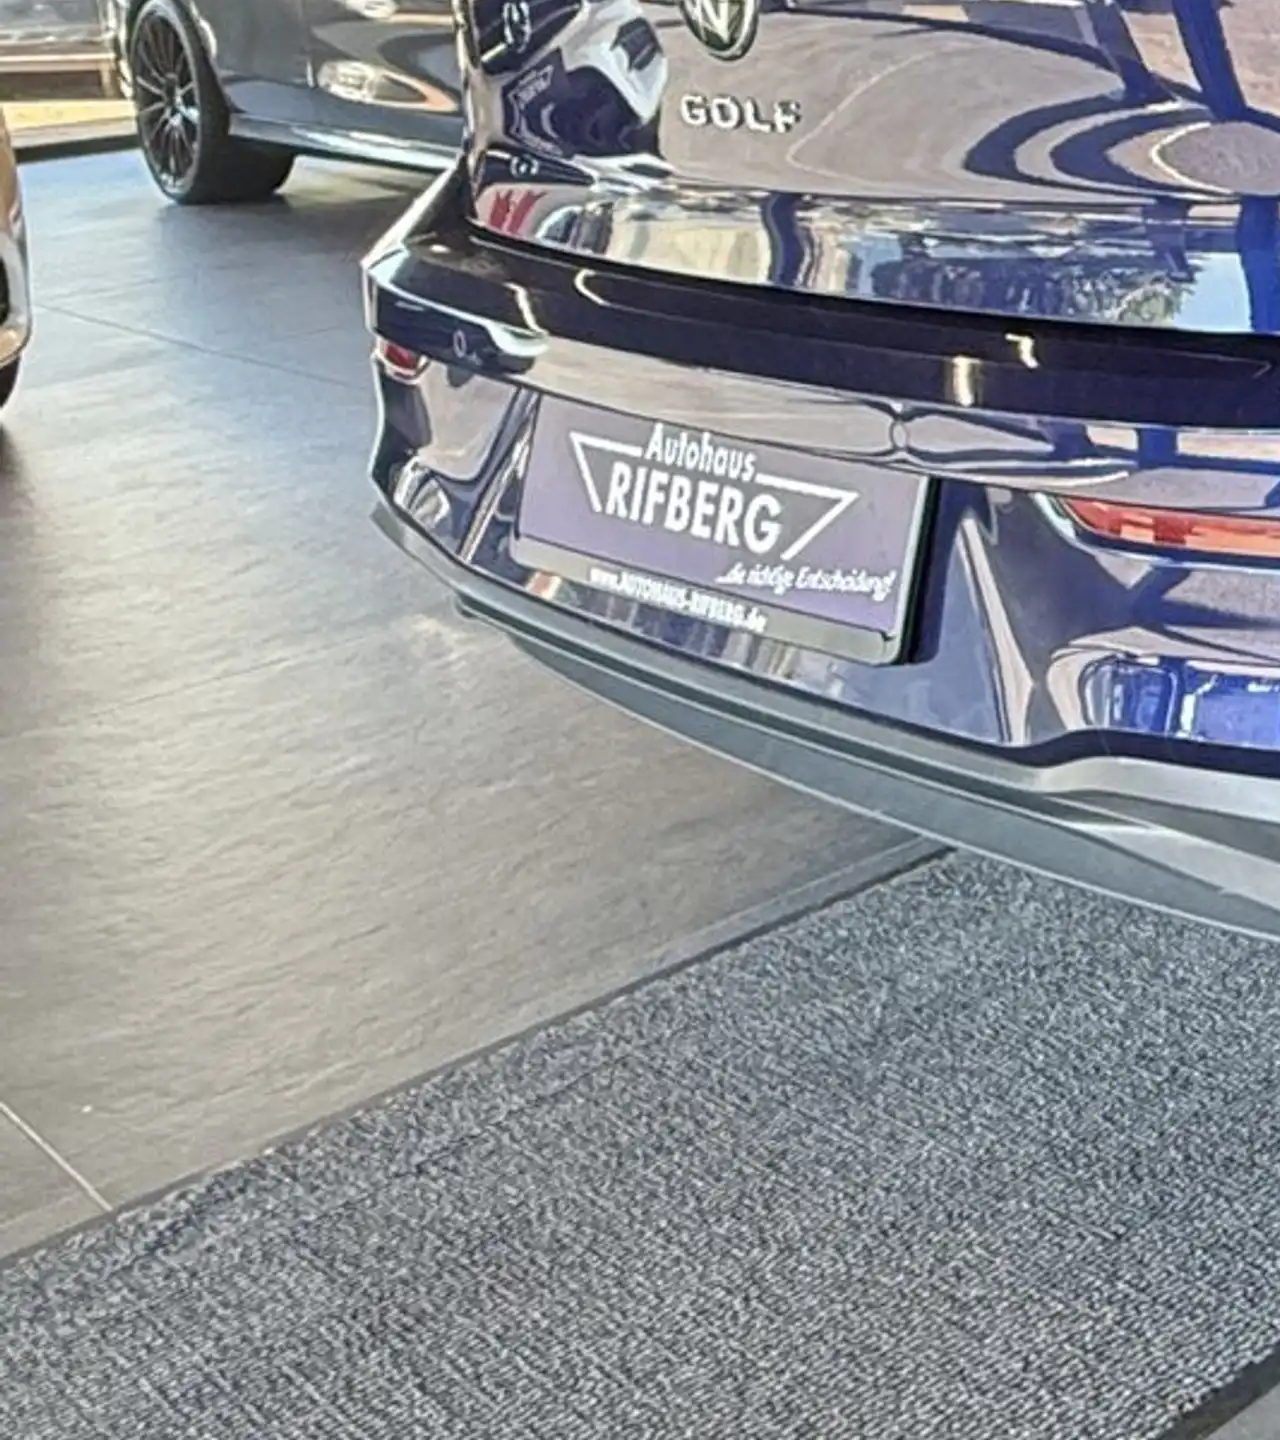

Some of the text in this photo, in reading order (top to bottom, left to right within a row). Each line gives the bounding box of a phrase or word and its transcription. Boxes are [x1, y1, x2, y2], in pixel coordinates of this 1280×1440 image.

[680, 93, 802, 133] GOLF
[644, 422, 758, 483] Autohaus
[605, 461, 783, 554] RIFBERG
